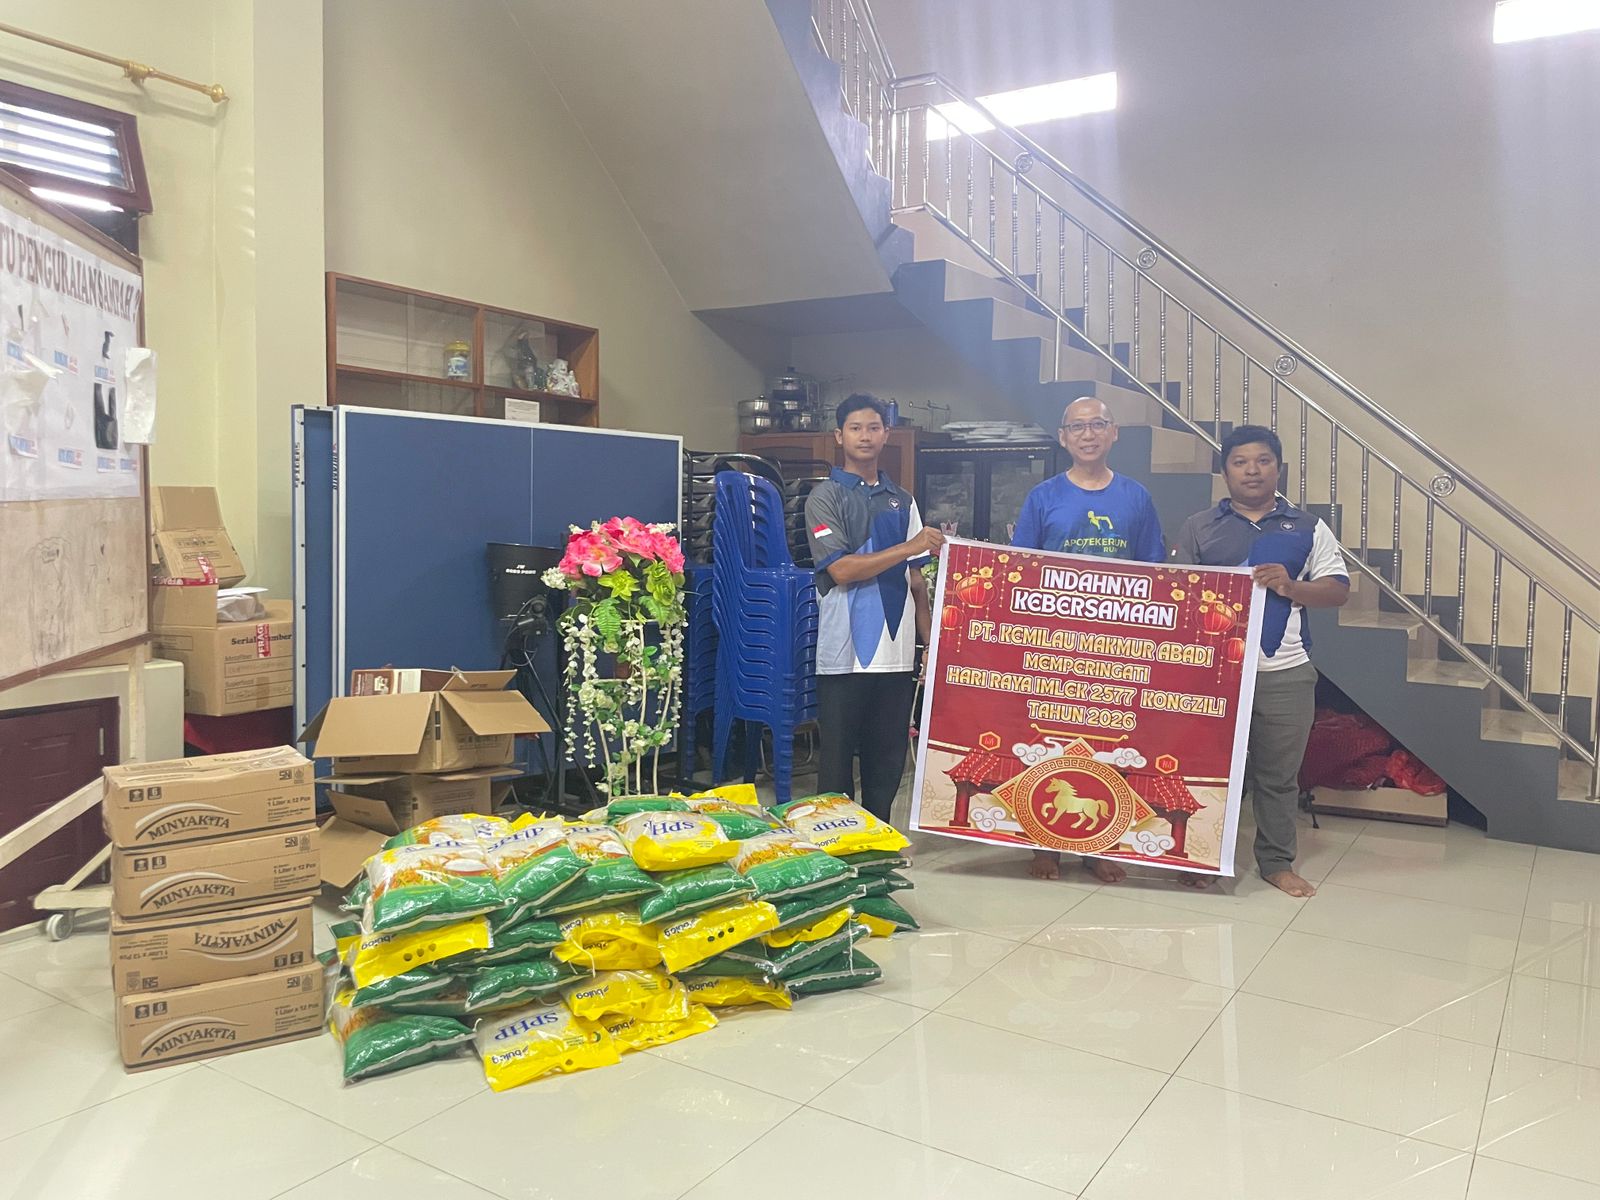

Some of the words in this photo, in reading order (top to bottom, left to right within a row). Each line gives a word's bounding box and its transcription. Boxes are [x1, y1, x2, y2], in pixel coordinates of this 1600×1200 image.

[18, 231, 98, 308] PENGURAIAN
[98, 269, 134, 321] SAMPAH
[1043, 569, 1150, 598] INDAHNYA
[1013, 590, 1175, 627] KEBERSAMAAN
[968, 621, 997, 643] PT.
[999, 622, 1077, 652] KEMILAU
[1078, 633, 1155, 661] MAKMUR
[1157, 642, 1214, 667] ABADI
[1023, 652, 1151, 683] MEMPERINGATI
[946, 665, 988, 687] HARI
[989, 672, 1033, 694] RAYA
[1034, 677, 1089, 700] IMLEK
[1089, 684, 1137, 706] 2577
[1140, 690, 1227, 717] KONGZILI
[1027, 700, 1085, 724] TAHUN
[1086, 708, 1137, 731] 2026
[813, 817, 859, 832] SPHP
[576, 987, 604, 1000] bulog
[494, 1012, 559, 1041] SPHP
[608, 1020, 630, 1034] bulo
